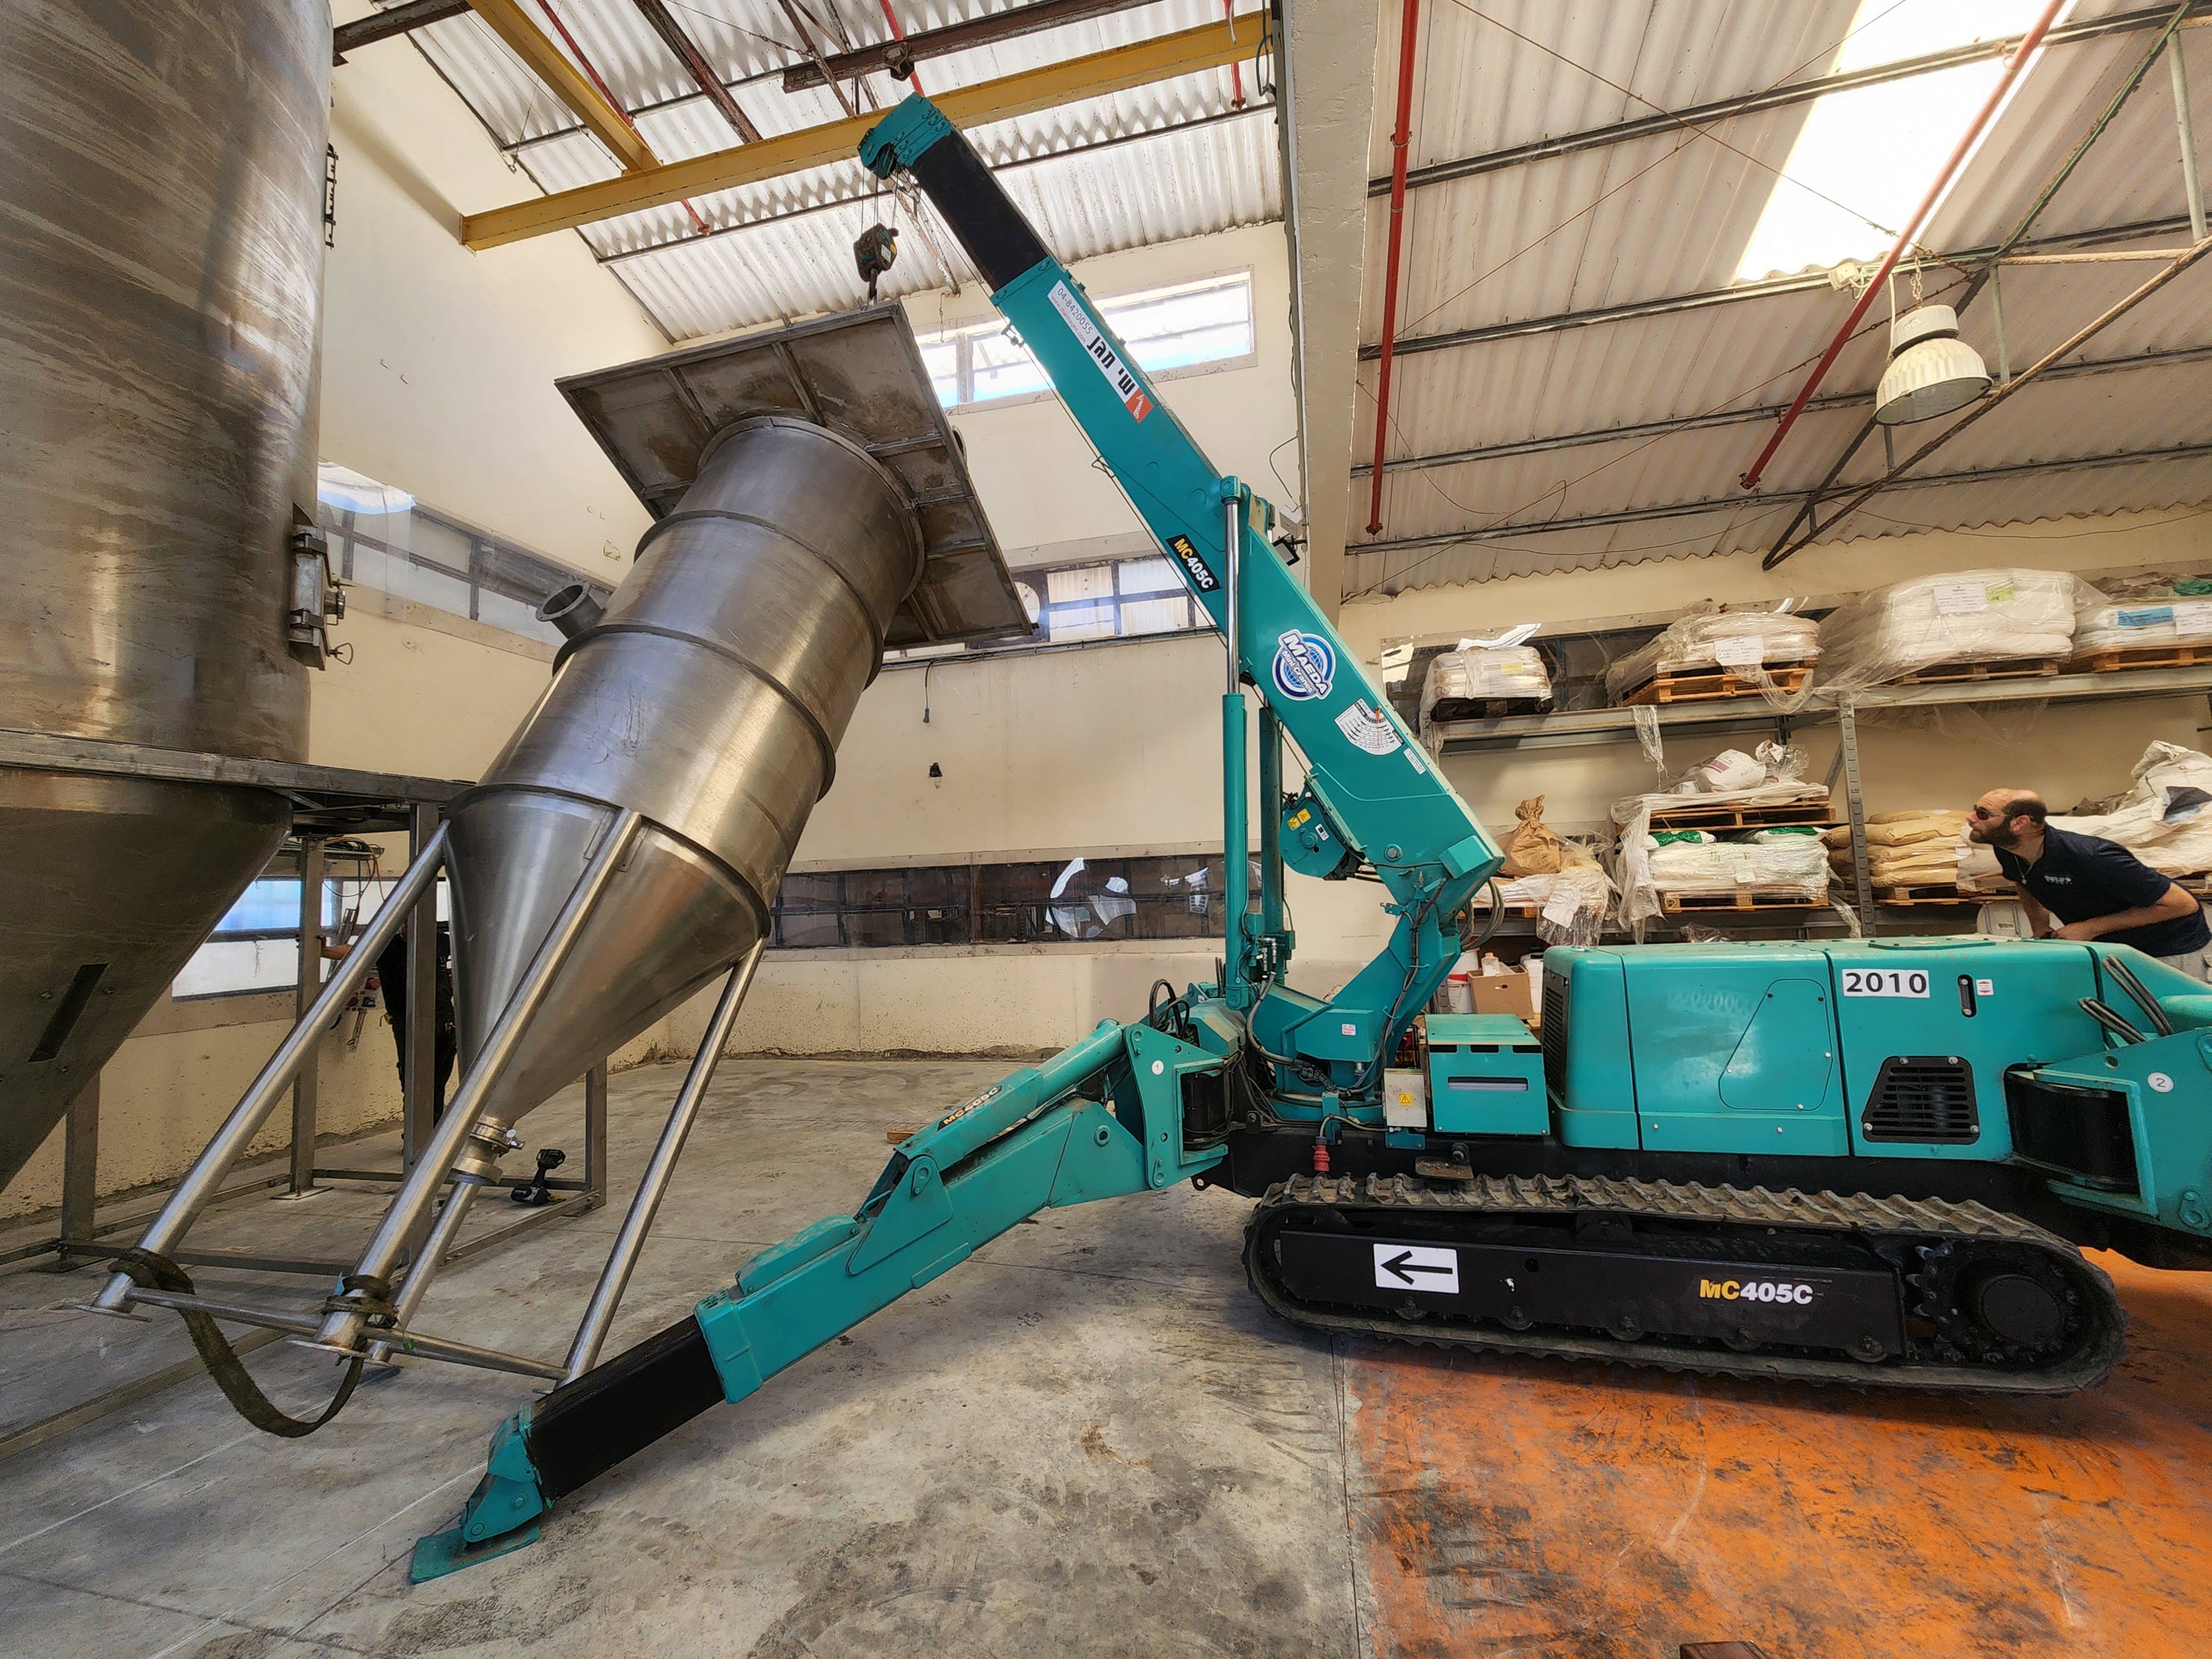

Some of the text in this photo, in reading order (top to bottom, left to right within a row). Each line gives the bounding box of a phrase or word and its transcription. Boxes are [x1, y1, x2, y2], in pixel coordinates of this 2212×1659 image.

[1051, 295, 1087, 343] www.shaimagen.com
[1057, 288, 1093, 335] 04-8420055
[1087, 335, 1136, 396] שי מגן
[1173, 538, 1213, 589] MC405C
[1281, 650, 1314, 694] Mini Cranes
[1282, 633, 1329, 695] MAEDA
[1845, 973, 1927, 994] 2010
[2156, 1078, 2166, 1087] 2
[943, 1087, 1000, 1124] MC405C
[1699, 1279, 1813, 1305] MC405C
